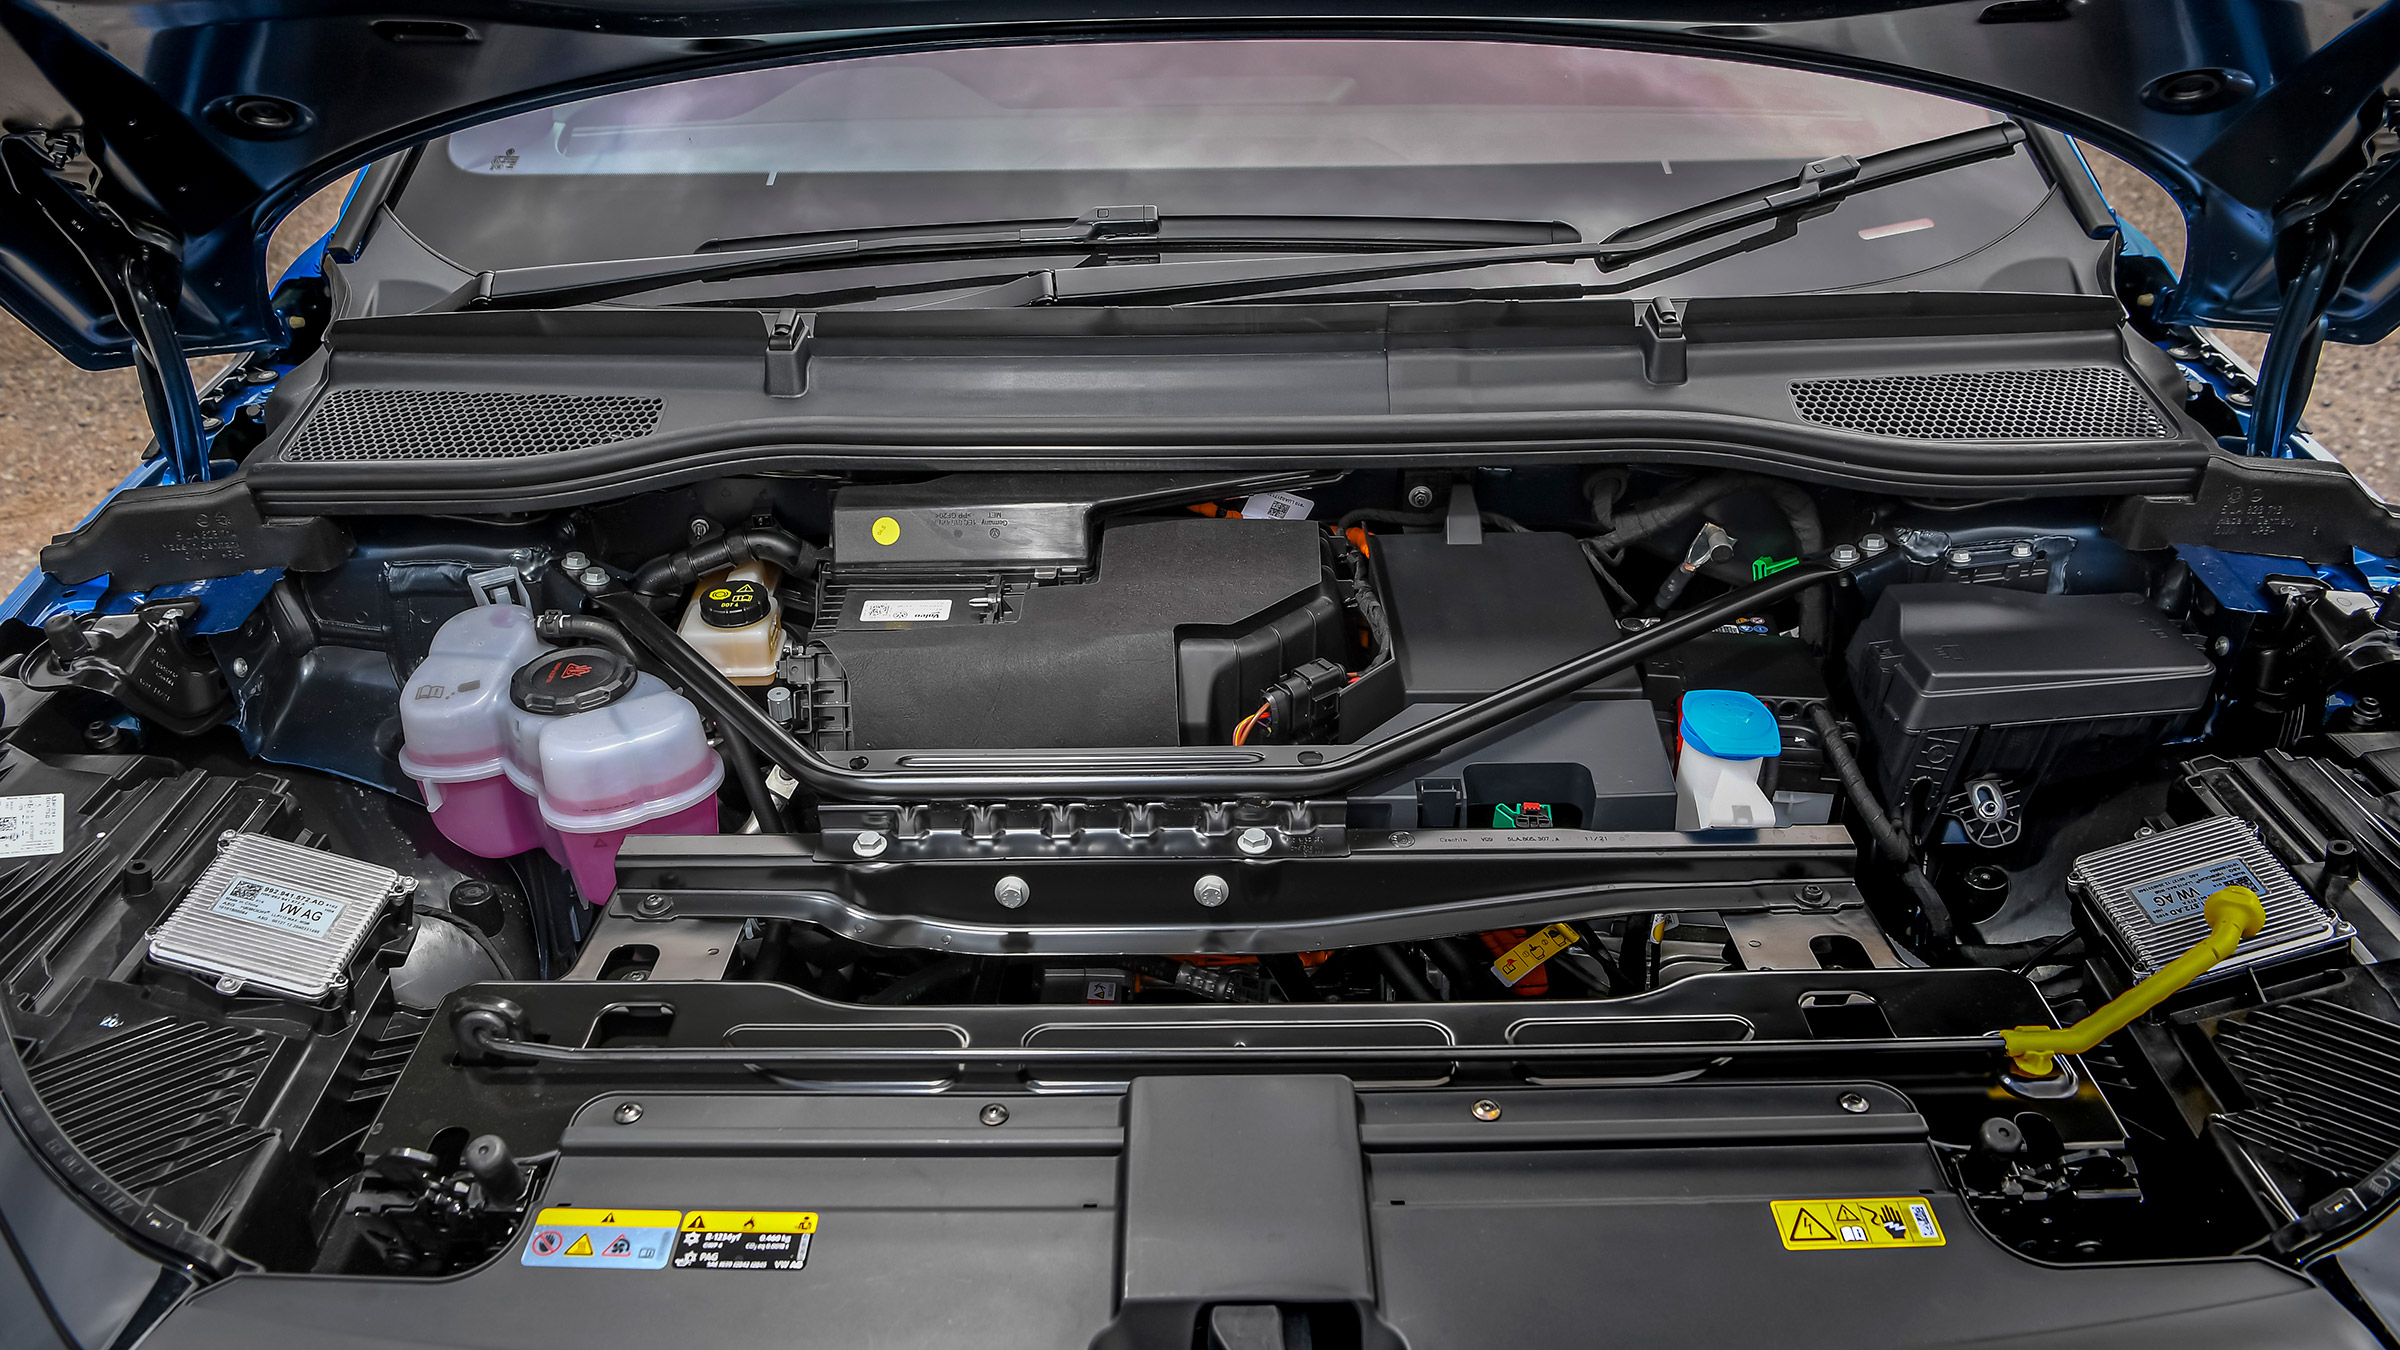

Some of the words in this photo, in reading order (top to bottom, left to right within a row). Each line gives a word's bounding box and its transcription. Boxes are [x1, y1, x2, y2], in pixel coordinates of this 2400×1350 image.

[2151, 893, 2176, 906] AG
[2174, 886, 2201, 900] VW
[276, 902, 302, 916] VW
[299, 908, 324, 921] AG
[45, 1137, 68, 1157] ECE
[61, 1154, 87, 1176] ONLY
[704, 1233, 742, 1243] R-1234yf
[699, 1252, 719, 1261] PAG
[774, 1260, 789, 1269] VW
[789, 1260, 804, 1269] AG
